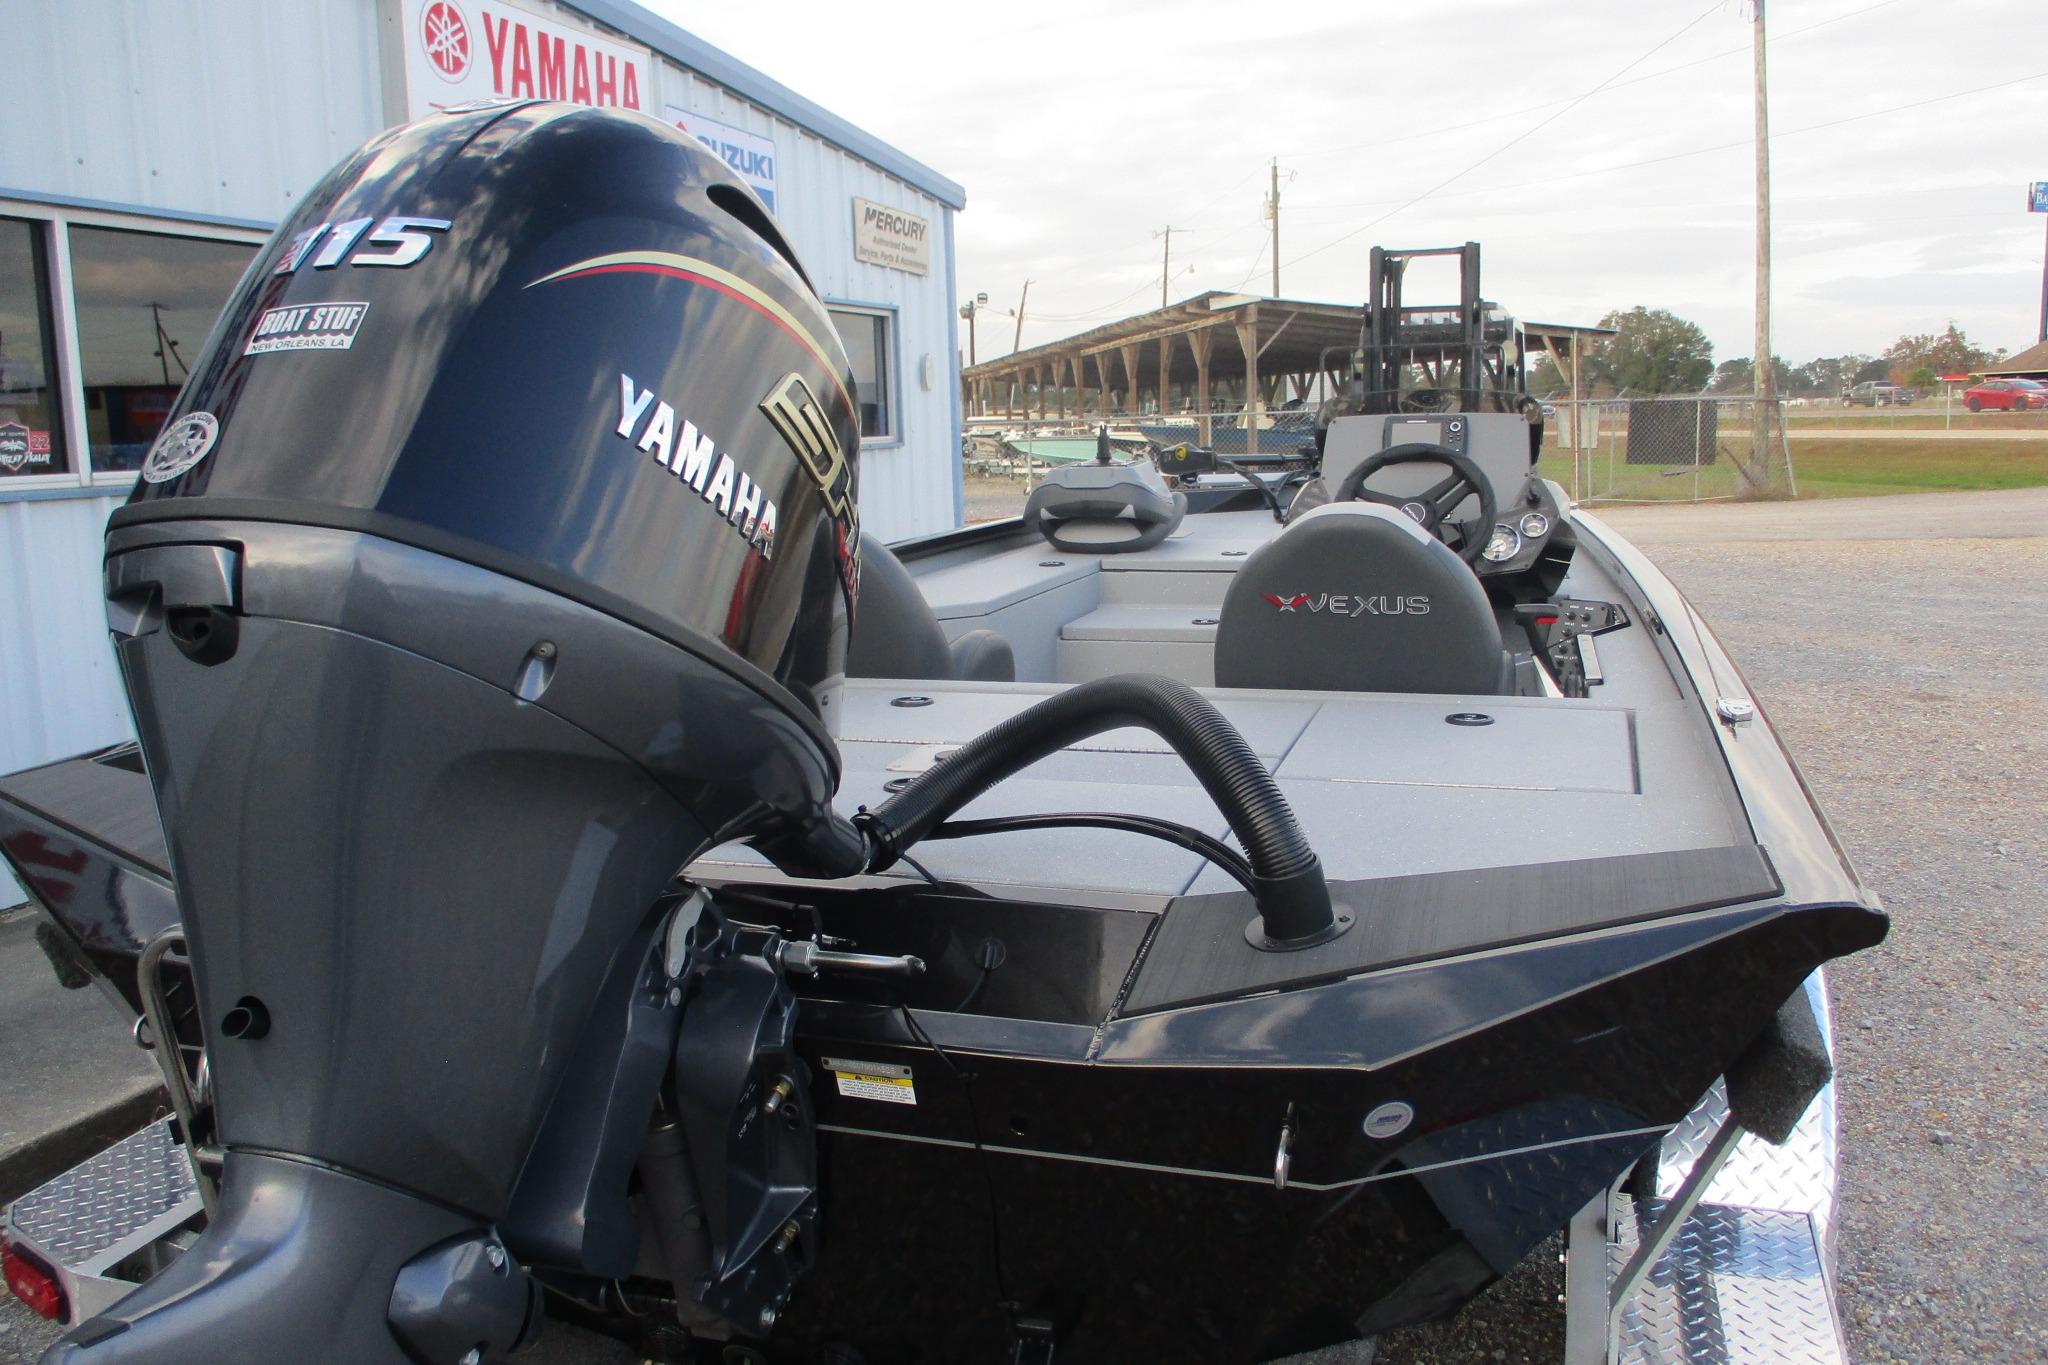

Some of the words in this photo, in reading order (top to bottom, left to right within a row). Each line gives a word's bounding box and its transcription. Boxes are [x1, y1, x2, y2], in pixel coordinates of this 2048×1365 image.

[482, 11, 640, 111] YAMAHA
[864, 207, 926, 241] MERCURY
[273, 216, 453, 277] 115
[257, 308, 311, 336] BOAT
[308, 306, 362, 331] STUF
[250, 342, 273, 352] NEW
[330, 339, 345, 347] LA
[31, 435, 50, 449] 22
[615, 373, 777, 561] YAMAHA
[1301, 592, 1430, 617] VEXUS
